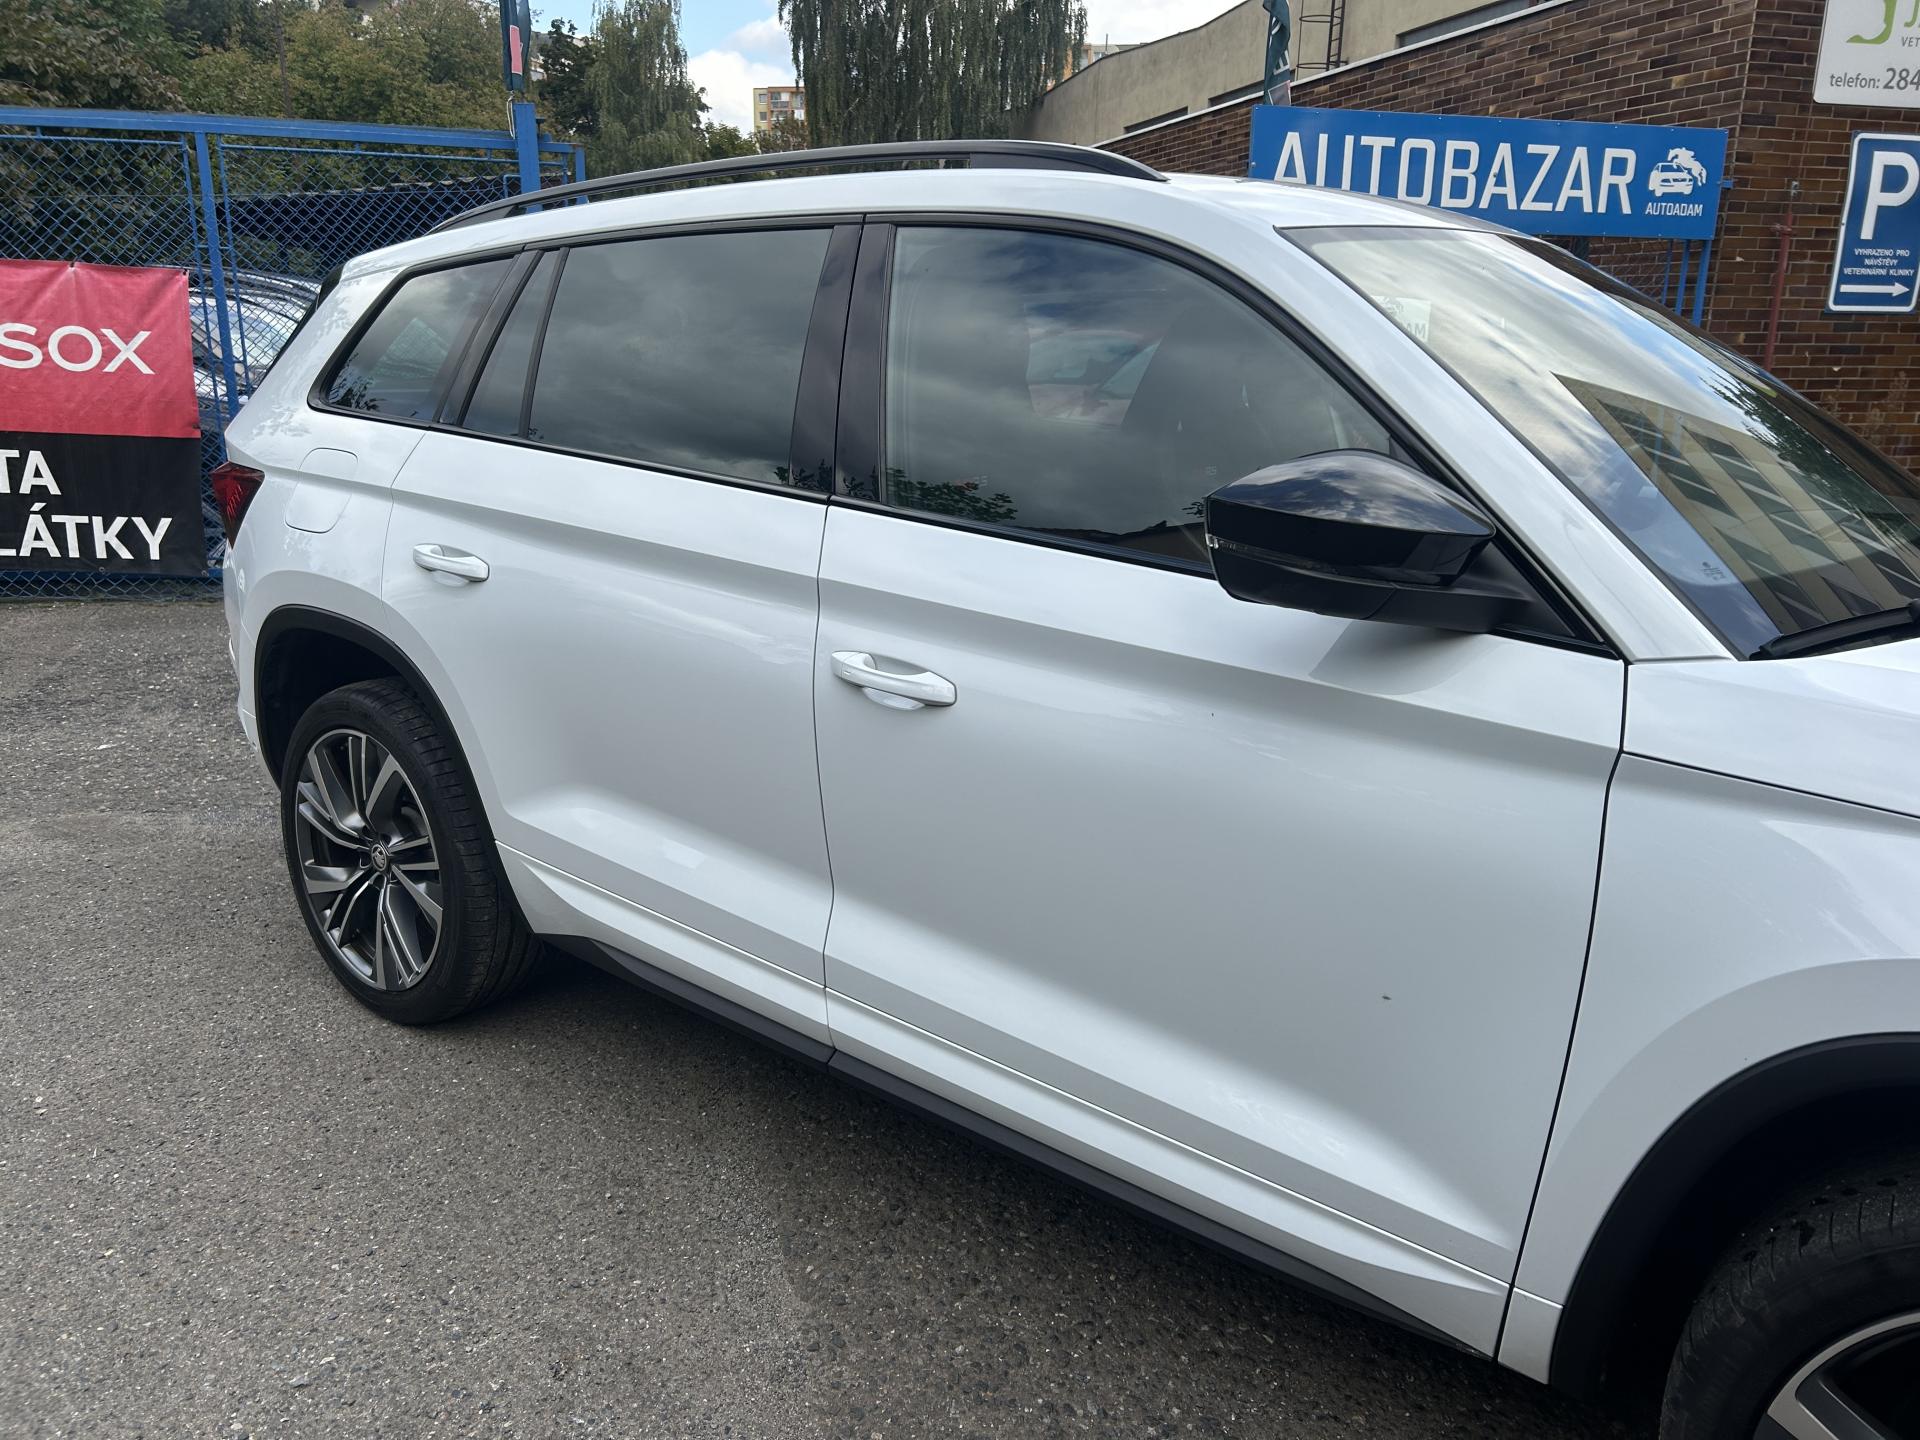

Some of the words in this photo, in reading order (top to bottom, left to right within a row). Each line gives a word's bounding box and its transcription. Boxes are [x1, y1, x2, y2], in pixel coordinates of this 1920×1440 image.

[1830, 72, 1881, 89] telefon:
[1273, 131, 1637, 215] AUTOBAZAR
[1860, 151, 1920, 240] P
[1645, 202, 1704, 217] AUTOADAM
[1854, 248, 1894, 257] VYHRAZENO
[1896, 249, 1910, 257] PRO
